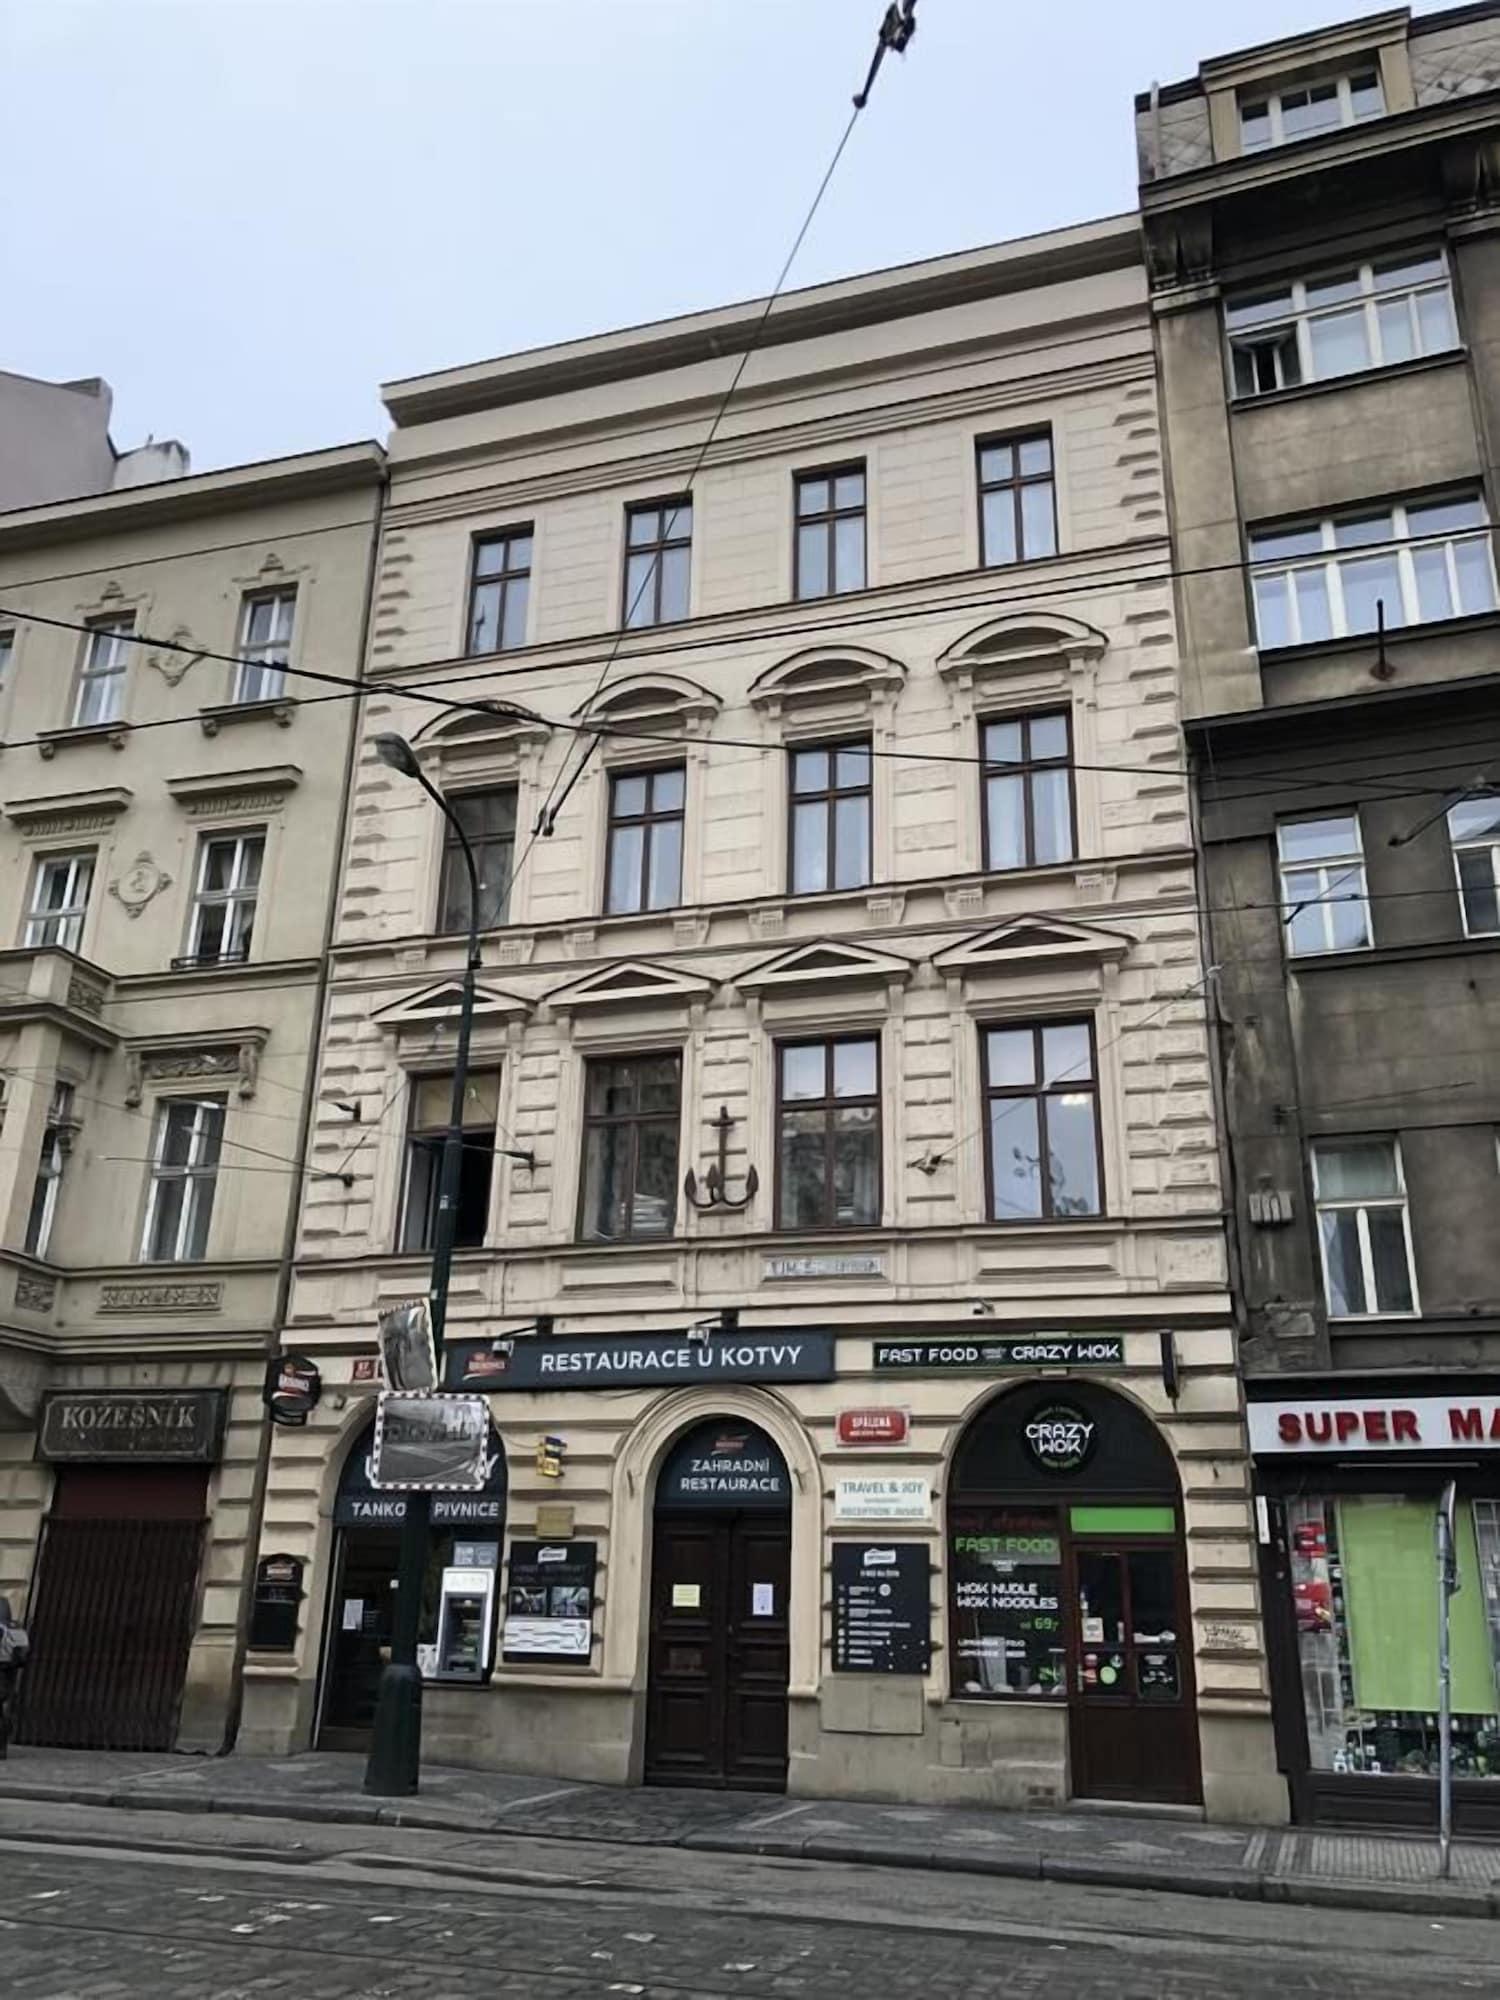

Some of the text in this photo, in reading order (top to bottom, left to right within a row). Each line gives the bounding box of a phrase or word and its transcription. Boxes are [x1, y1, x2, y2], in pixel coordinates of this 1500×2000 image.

[879, 1348, 923, 1363] FAST
[928, 1348, 979, 1362] FOOD
[1011, 1345, 1073, 1360] CRAZY
[1076, 1343, 1120, 1358] WOK
[540, 1346, 803, 1373] RESTAURACE U KOTVY
[61, 1399, 196, 1429] KOŽEŠNÍK
[1025, 1422, 1095, 1439] CRAZY
[1278, 1408, 1500, 1444] SUPER M
[1038, 1438, 1083, 1455] WOK
[691, 1458, 770, 1473] ZAHRADNÍ
[681, 1477, 781, 1491] RESTAURACE
[843, 1482, 885, 1494] TRAVEL
[889, 1481, 898, 1493] &
[352, 1502, 499, 1517] TANKO PIVNICE
[955, 1537, 1057, 1553] FAST FOOD
[956, 1582, 1038, 1596] WOK NUDLE
[956, 1595, 1058, 1610] WOK NOODLES
